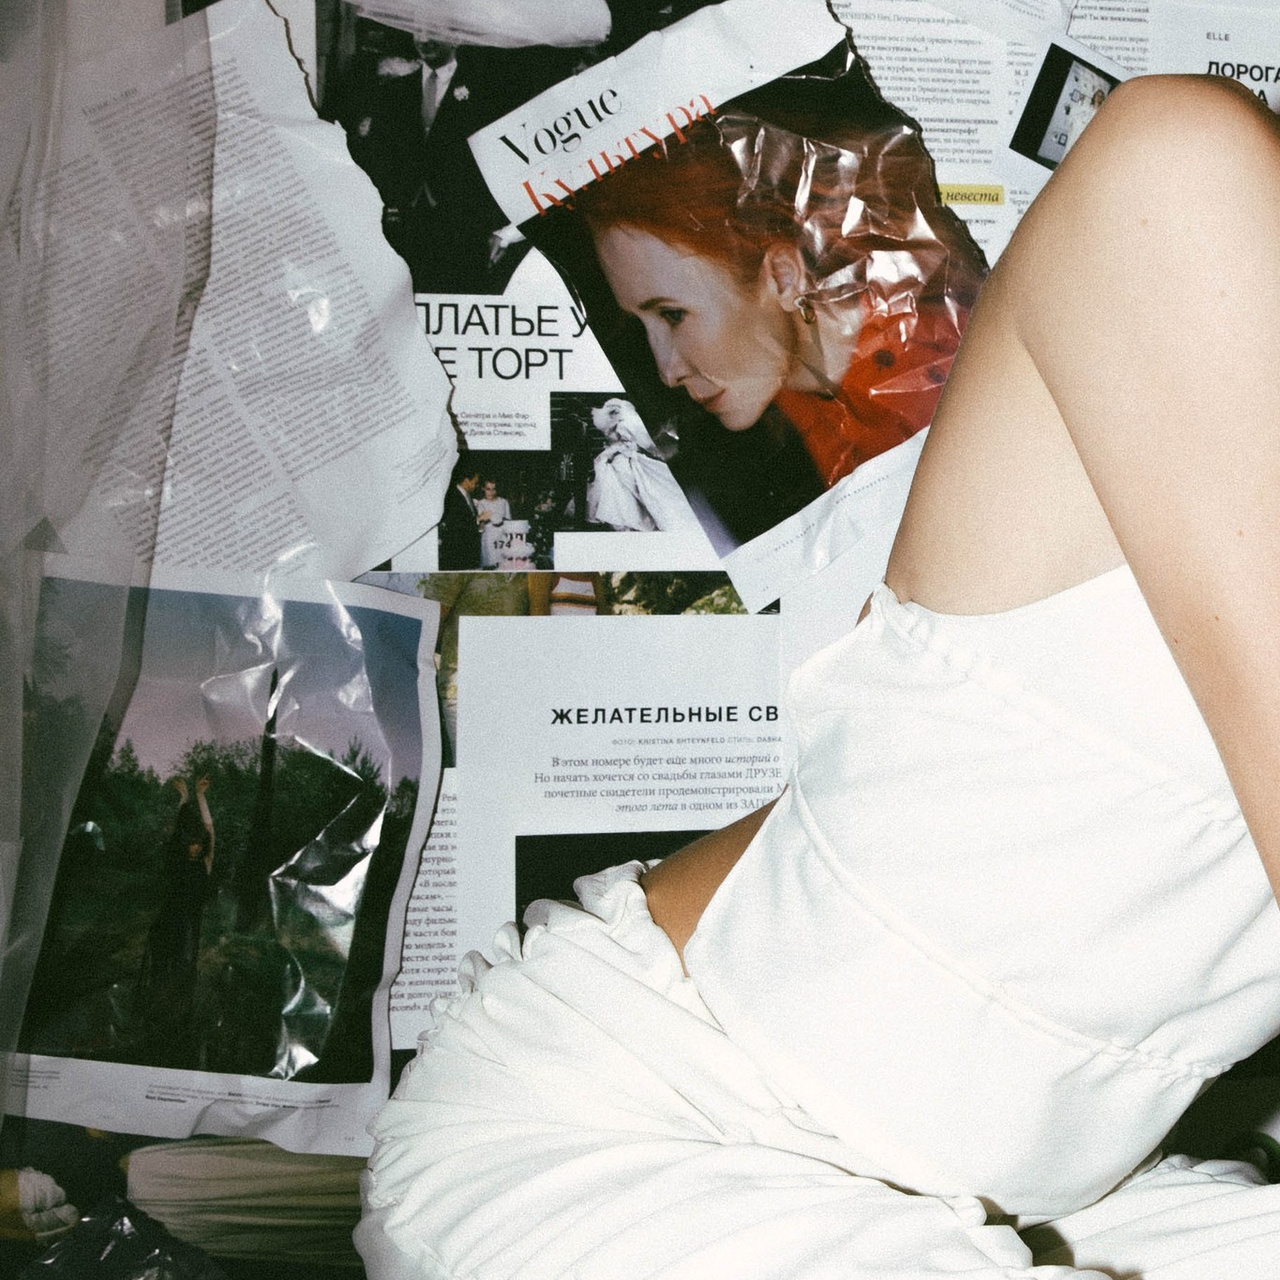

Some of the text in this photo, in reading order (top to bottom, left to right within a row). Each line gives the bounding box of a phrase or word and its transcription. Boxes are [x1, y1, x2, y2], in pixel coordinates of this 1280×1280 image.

[1206, 32, 1230, 42] ELLE
[498, 88, 622, 166] Vogue
[522, 94, 718, 217] Культура
[945, 190, 1000, 203] невеста
[467, 346, 573, 381] ТОРТ
[493, 540, 511, 549] 174
[551, 706, 779, 725] ЖЕЛАТЕЛЬНЫЕ СВ
[552, 758, 560, 767] В
[561, 759, 588, 767] этом
[591, 758, 631, 768] номере
[633, 755, 663, 771] будет
[690, 756, 722, 765] много
[725, 754, 771, 766] историй
[534, 773, 550, 784] Но
[553, 774, 590, 784] начать
[593, 773, 635, 784] хочется
[638, 774, 650, 782] со
[652, 769, 697, 783] свадьбы
[700, 771, 743, 780] глазами
[544, 785, 774, 800] почетные свидетели продемонстрировали
[615, 804, 648, 814] этого
[650, 802, 678, 812] лета
[690, 802, 723, 812] одном
[726, 801, 738, 809] из
